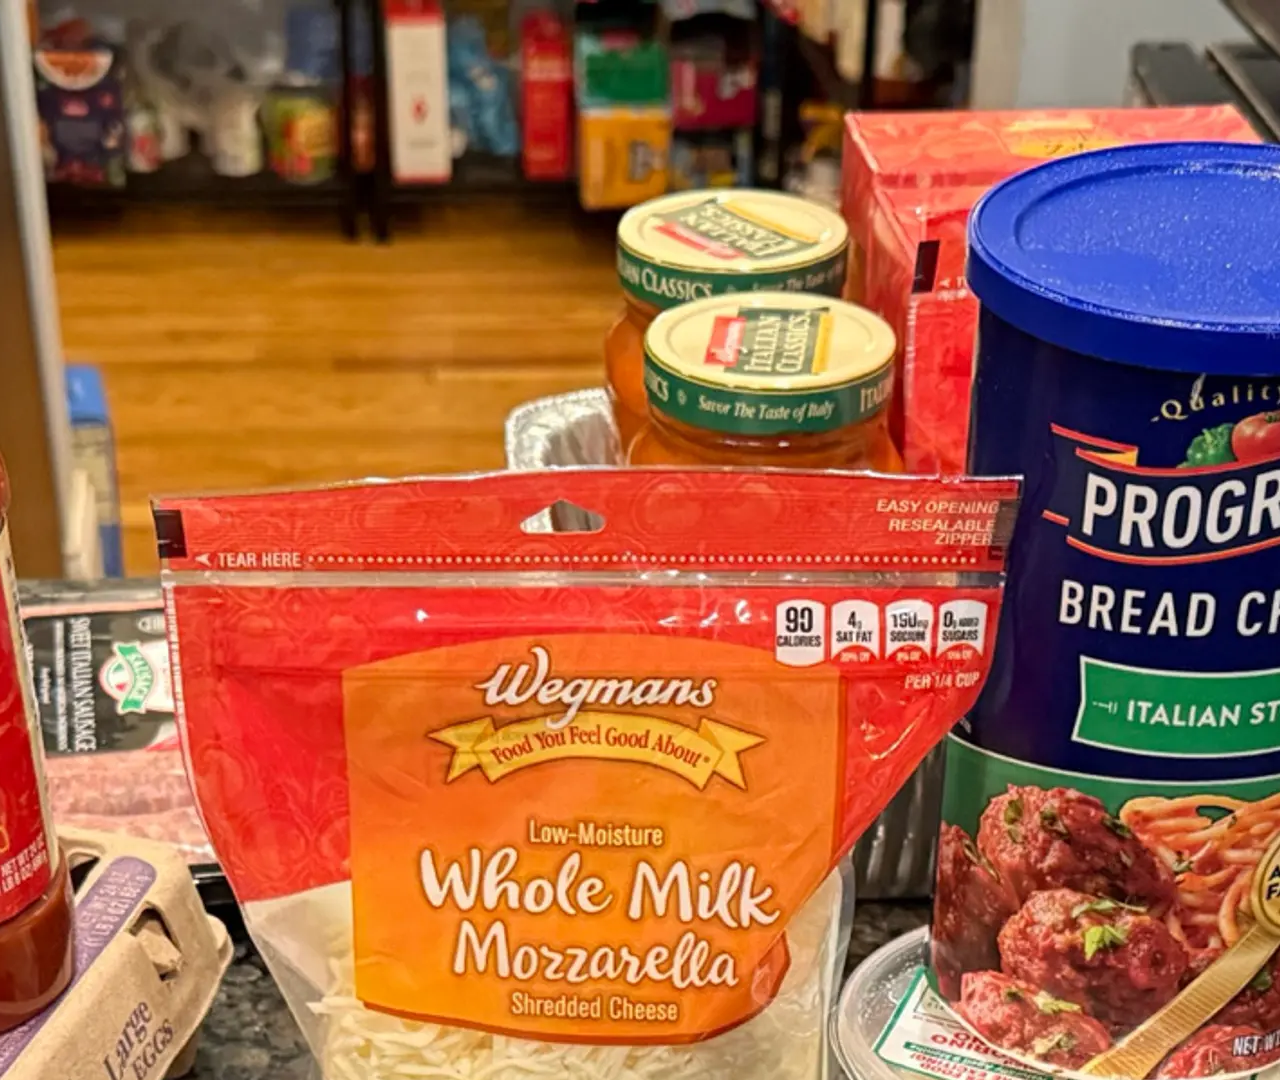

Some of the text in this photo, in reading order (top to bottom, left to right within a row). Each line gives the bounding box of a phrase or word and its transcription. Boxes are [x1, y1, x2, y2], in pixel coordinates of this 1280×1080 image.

[744, 314, 781, 373] ITALIAN
[698, 395, 835, 424] Savor The Taste of Italy
[876, 499, 1000, 514] EASY OPENING
[889, 519, 996, 533] RESEALABLE
[935, 533, 993, 546] ZIPPER
[218, 552, 301, 568] TEAR HERE
[785, 606, 814, 634] 90
[1059, 579, 1217, 637] BREAD
[777, 634, 822, 647] CALORIES
[836, 631, 873, 643] SAT FAT
[890, 631, 926, 643] SODIUM
[942, 630, 979, 642] SUGARS
[70, 617, 96, 752] SWEET ITALIAN SAUSAGE
[472, 645, 718, 730] Wegmans
[905, 672, 980, 689] PER 1/4 CUP
[1126, 699, 1241, 729] ITALIAN
[491, 738, 534, 765] Food
[535, 729, 566, 750] You
[568, 724, 602, 746] Feel
[605, 727, 650, 749] Good
[528, 819, 664, 848] Low-Moisture
[0, 857, 19, 878] NET
[420, 846, 782, 928] Whole Milk
[452, 919, 739, 990] Mozzarella
[511, 992, 678, 1022] Shredded Cheese
[1232, 1035, 1259, 1057] NET
[910, 1053, 988, 1077] EXCITING!
[920, 1063, 963, 1079] FOOD
